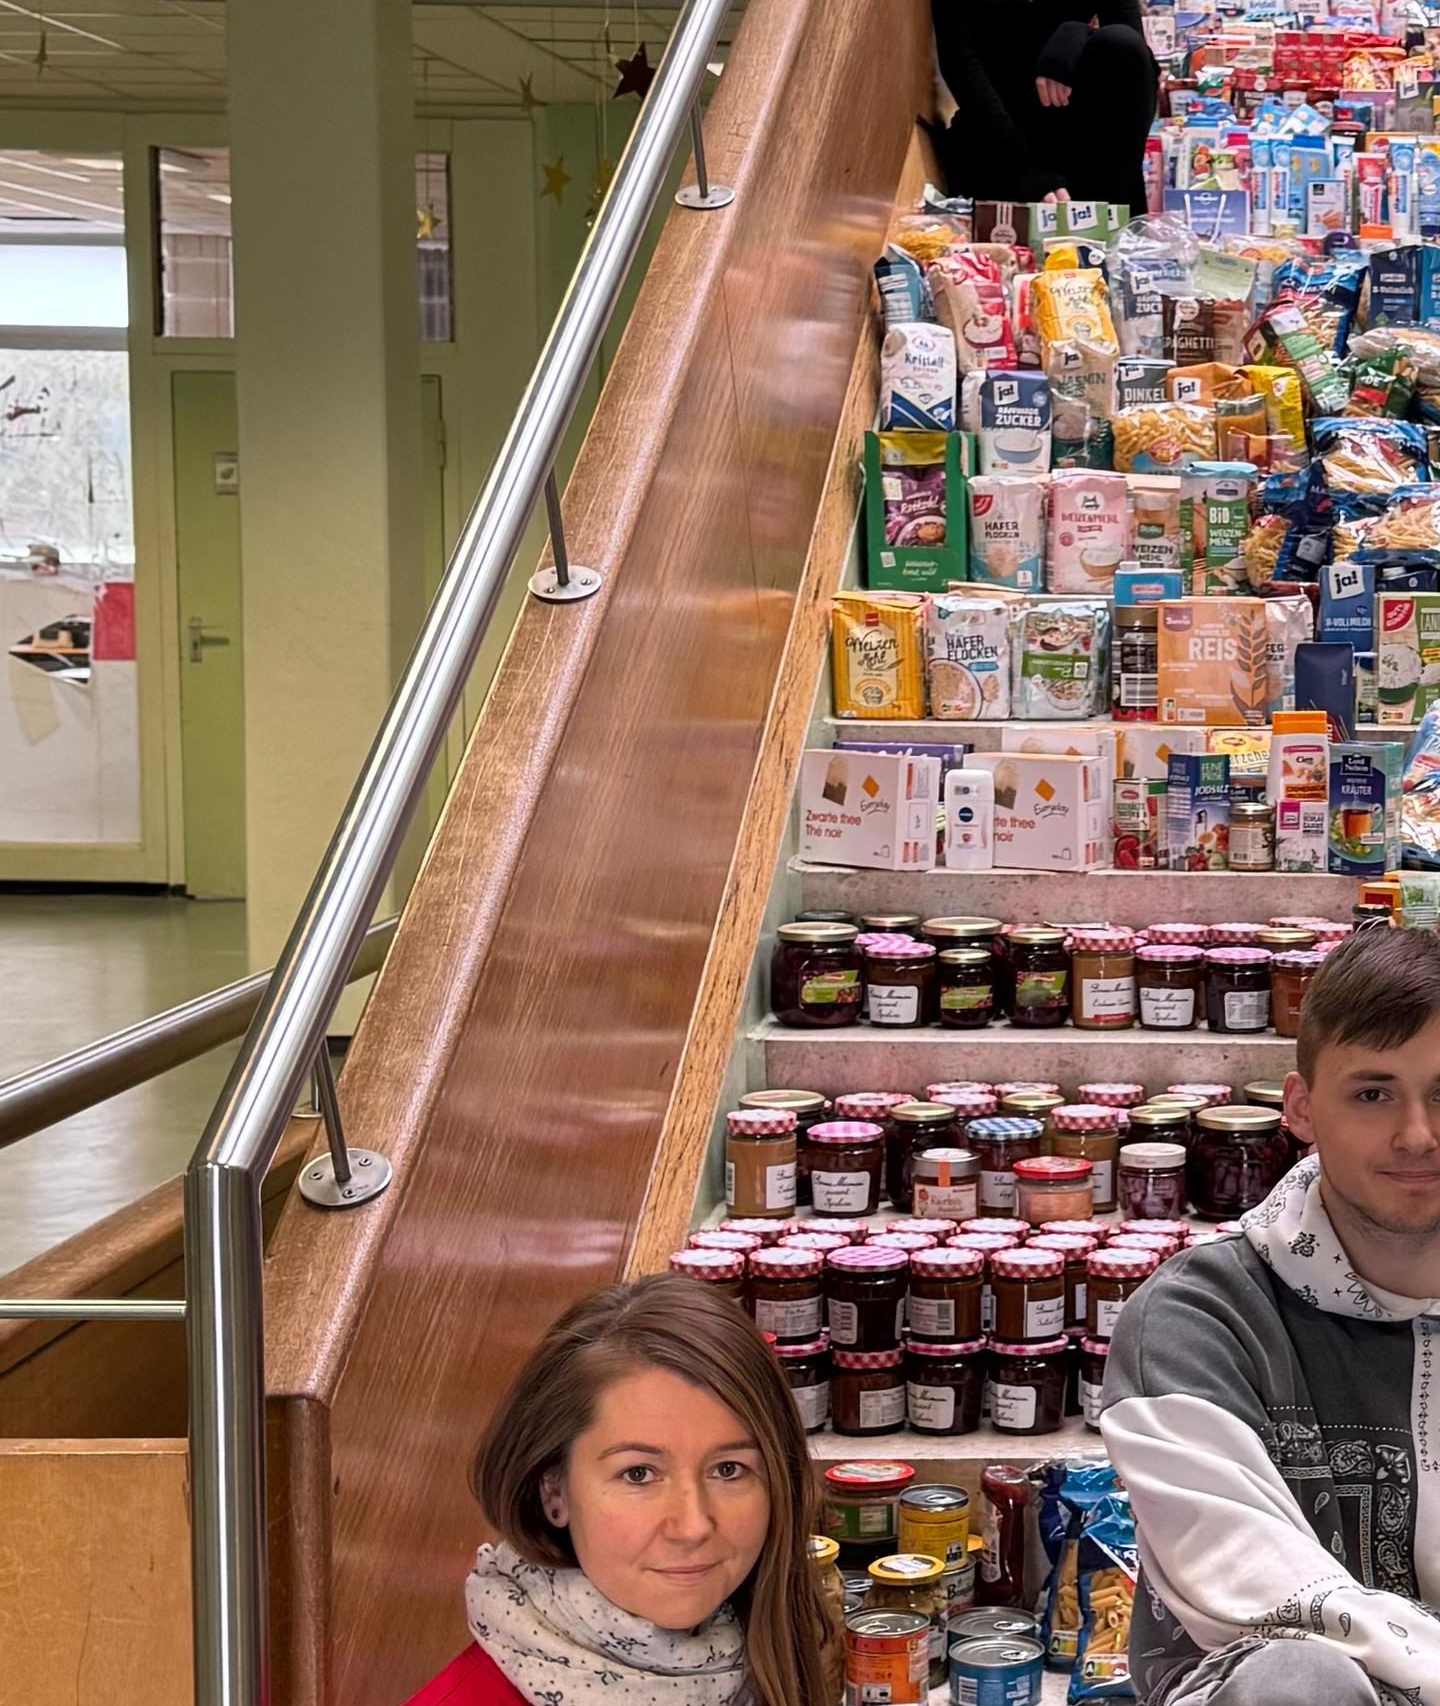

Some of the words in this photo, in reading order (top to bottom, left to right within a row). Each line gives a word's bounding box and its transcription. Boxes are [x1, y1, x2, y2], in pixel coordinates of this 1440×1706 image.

[1072, 207, 1092, 229] ja!
[997, 383, 1015, 402] ja!
[1124, 387, 1166, 403] DINKEL
[1176, 380, 1197, 399] ja!
[995, 413, 1042, 428] ZUCKER
[1335, 571, 1359, 594] ja!
[845, 634, 899, 653] Weizen
[946, 634, 985, 650] HAFER
[1188, 637, 1238, 661] REIS
[947, 646, 999, 662] FLOCKEN
[805, 809, 838, 824] Zwarte
[839, 812, 862, 826] thee
[1011, 816, 1036, 830] thee
[824, 825, 843, 839] noir
